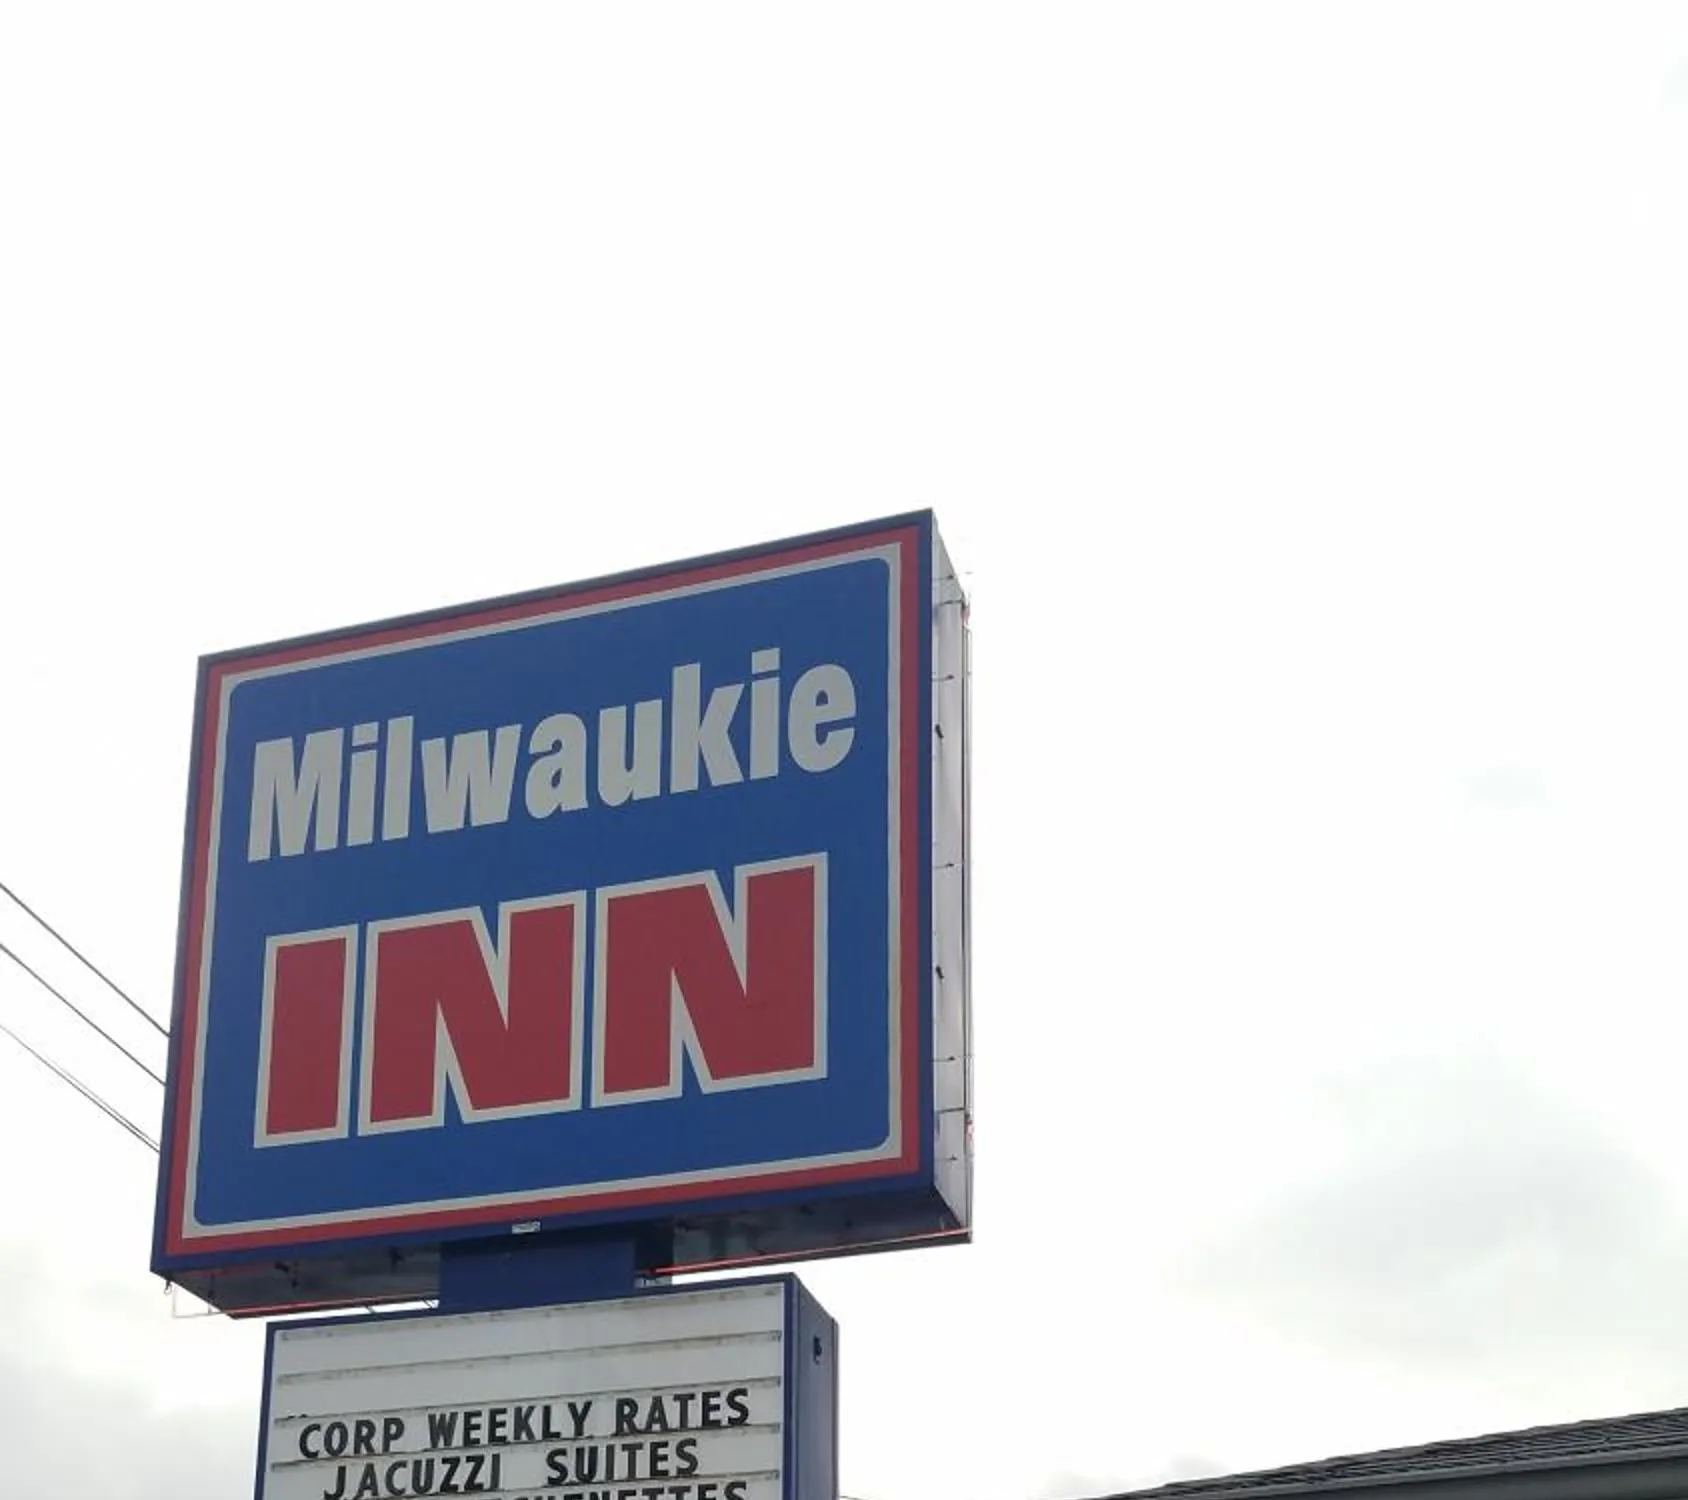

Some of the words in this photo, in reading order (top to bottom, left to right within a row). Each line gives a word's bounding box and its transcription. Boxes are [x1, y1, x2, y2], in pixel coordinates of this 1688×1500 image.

[247, 647, 857, 863] Milwaukie
[253, 851, 829, 1149] INN
[299, 1417, 405, 1459] CORP
[427, 1401, 593, 1450] WEEKLY
[615, 1387, 750, 1435] RATES
[545, 1438, 699, 1487] SUITES
